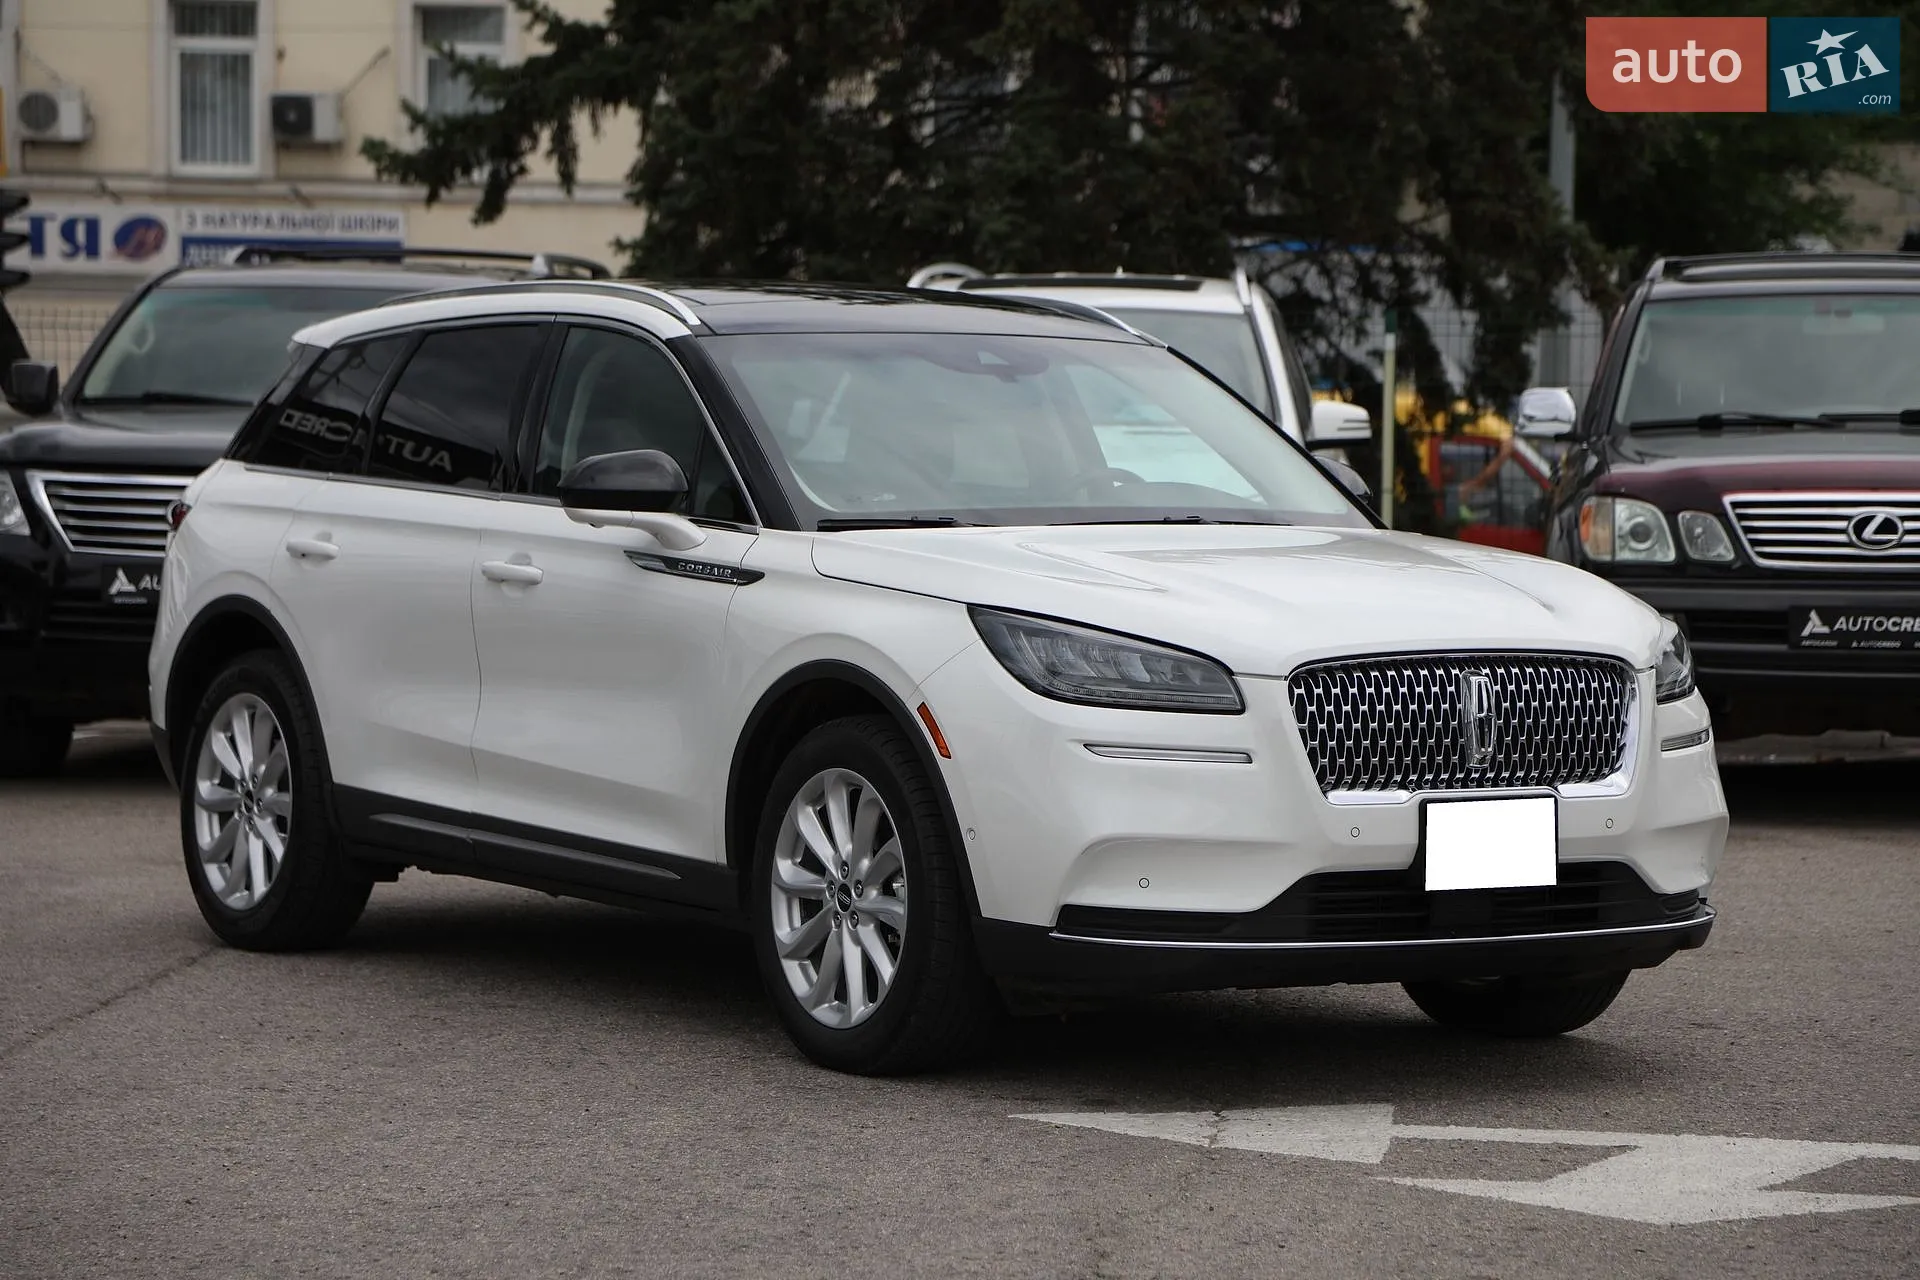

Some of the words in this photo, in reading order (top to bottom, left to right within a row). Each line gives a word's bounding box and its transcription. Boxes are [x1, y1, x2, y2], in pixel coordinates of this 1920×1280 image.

[203, 212, 335, 233] НАТУРАЛЬНОЇ
[340, 214, 400, 233] ШКІРИ
[677, 561, 732, 578] CORSAIR
